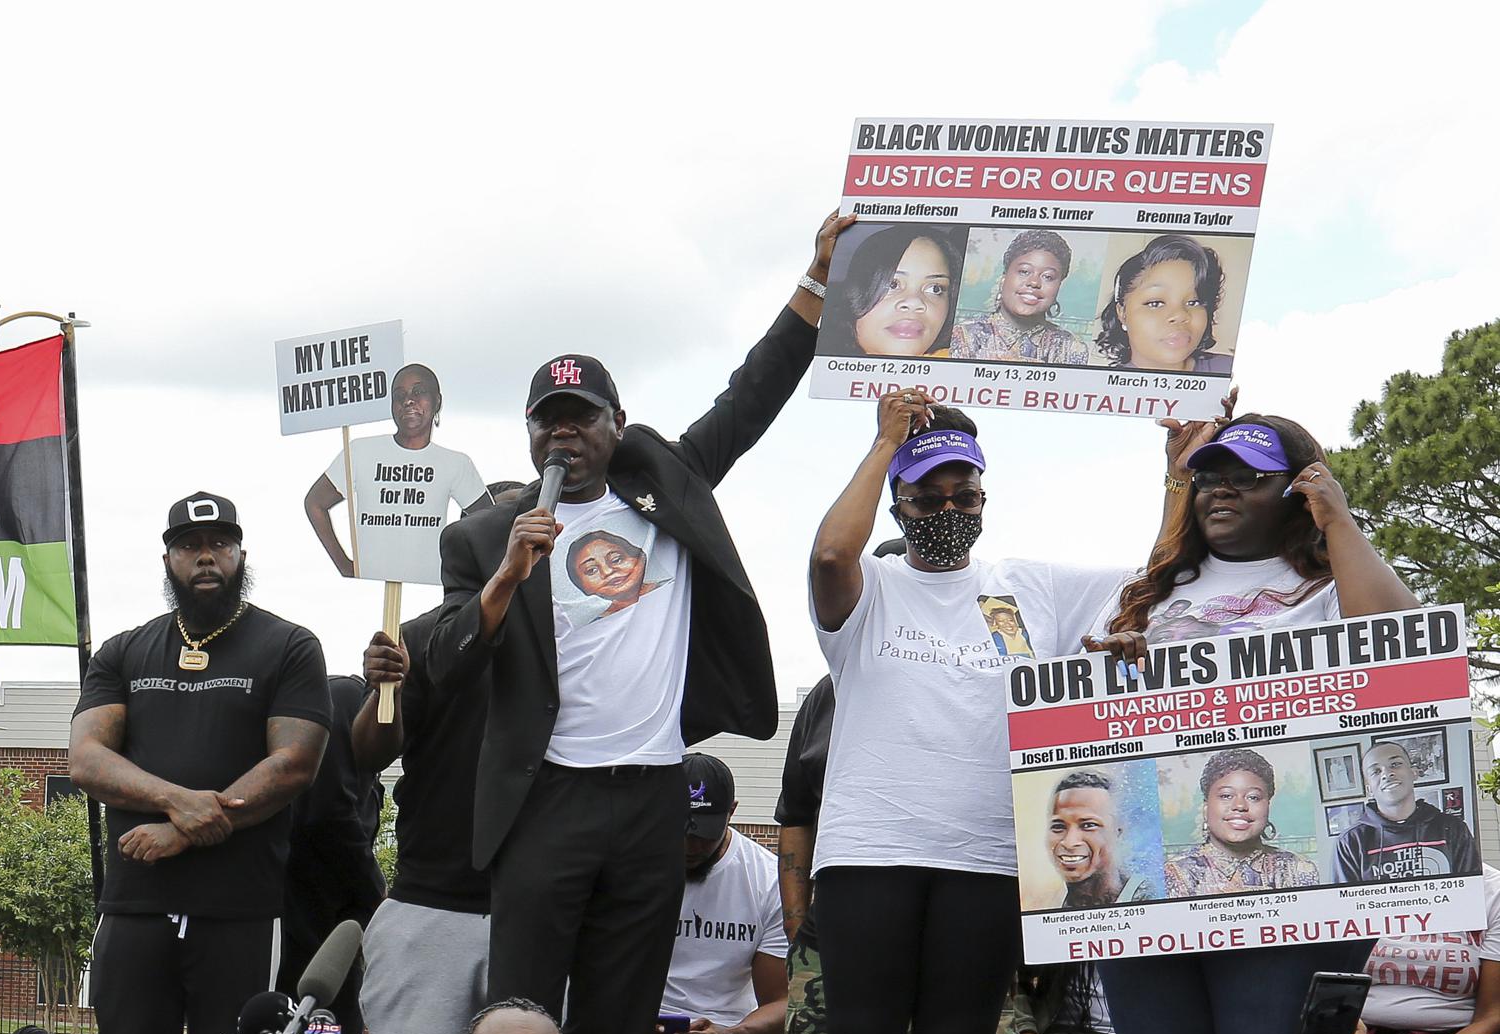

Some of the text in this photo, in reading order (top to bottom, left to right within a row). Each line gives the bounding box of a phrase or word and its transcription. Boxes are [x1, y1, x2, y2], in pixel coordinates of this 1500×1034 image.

[856, 123, 1264, 158] BLACK WOMEN LIVES MATTERS
[855, 165, 1252, 196] JUSTICE FOR OUR QUEENS
[853, 202, 959, 218] Atatiana Jefferson
[991, 205, 1094, 222] Pamela S. Turner
[1136, 210, 1233, 227] Breonna Taylor
[295, 335, 371, 375] MY LIFE
[827, 360, 931, 376] October 12, 2019
[974, 367, 1056, 383] May 13, 2019
[1107, 374, 1207, 391] March 13, 2020
[282, 370, 388, 414] MATTERED
[1023, 392, 1180, 417] BRUTALITY
[916, 433, 963, 447] Justice For
[1221, 429, 1250, 440] Justice
[1252, 429, 1269, 440] For
[1244, 435, 1273, 448] Turner
[911, 440, 969, 456] Pamela Turner
[373, 463, 435, 484] Justice
[379, 487, 425, 505] for Me
[360, 513, 442, 528] Pamela Turner
[894, 625, 991, 656] Jusic For
[877, 641, 948, 666] Pamela
[1010, 658, 1094, 708] OUR
[1228, 610, 1460, 680] MATTERED
[131, 678, 177, 692] PROTECT
[178, 682, 204, 692] OUR
[1093, 671, 1370, 720] UNARMED & MURDERED
[1107, 693, 1357, 739] BY POLICE OFFICERS
[1339, 704, 1440, 730] Stephon Clark
[1175, 723, 1288, 748] Pamela S. Turner
[1021, 738, 1144, 766] Josef D. Richardson
[1372, 858, 1423, 877] NORTH
[1340, 880, 1465, 898] Murdered March 18, 2018
[1189, 894, 1298, 912] Murdered May 13, 2019
[1356, 895, 1450, 910] in Sacramento, CA
[1042, 907, 1146, 925] Murdered July 25, 2019
[1209, 909, 1280, 924] in Baytown, TX
[1058, 921, 1131, 936] in Port Allen, LA
[1068, 939, 1126, 960] END
[1138, 927, 1247, 955] POLICE
[1259, 912, 1434, 945] BRUTALITY
[1372, 945, 1471, 963] MPOWER
